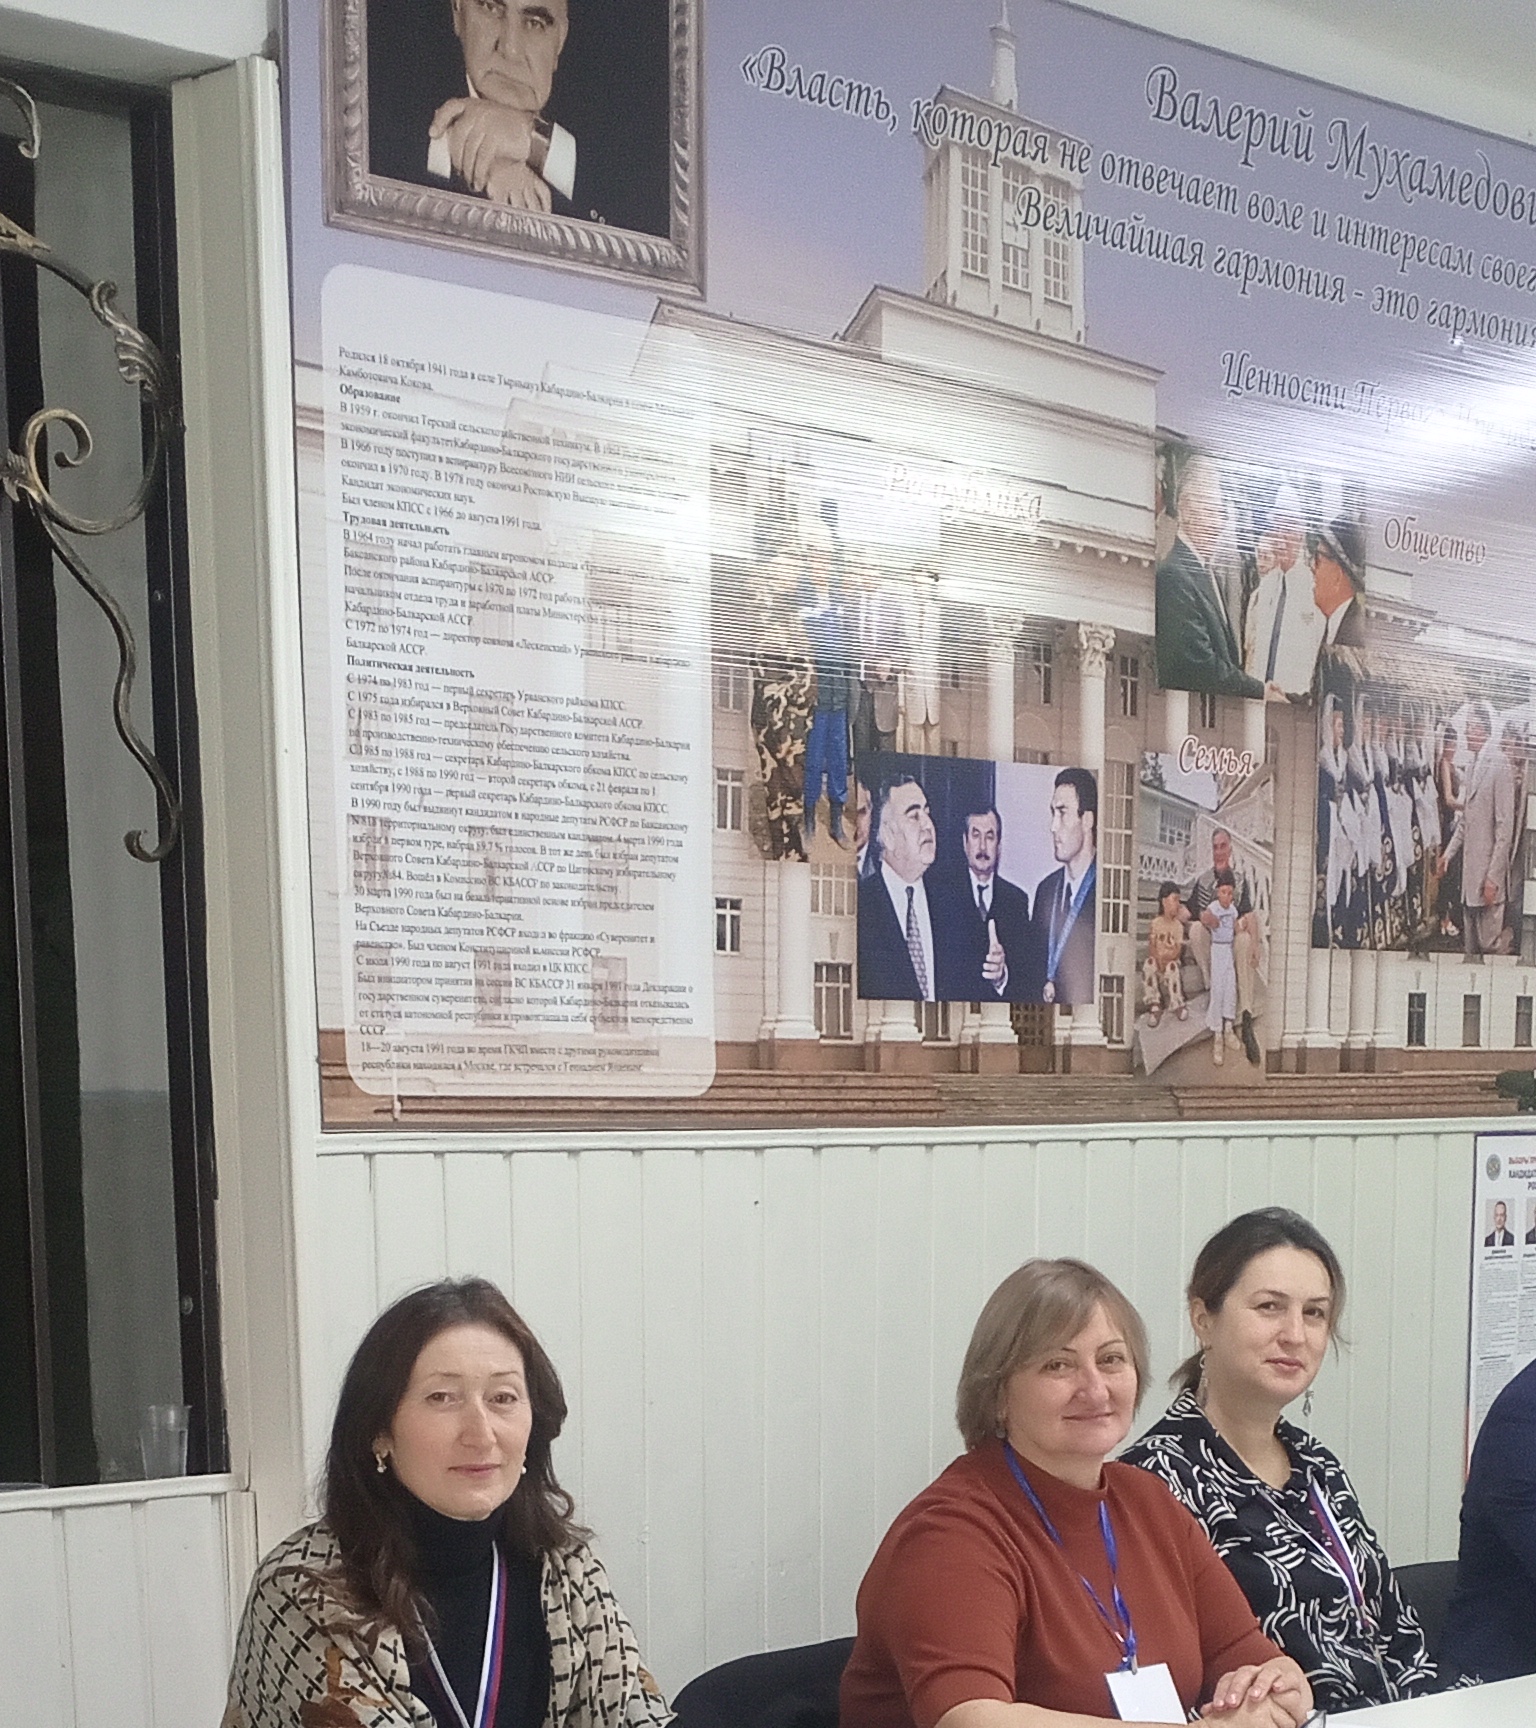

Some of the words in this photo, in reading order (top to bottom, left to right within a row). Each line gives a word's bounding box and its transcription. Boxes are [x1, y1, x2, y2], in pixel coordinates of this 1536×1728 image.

[1146, 64, 1315, 169] Валерий
[740, 45, 898, 135] «Власть,
[911, 96, 1050, 169] которая
[1058, 137, 1092, 174] не
[1100, 152, 1239, 215] отвечает
[1247, 191, 1304, 231] воле
[1312, 209, 1329, 239] и
[1335, 212, 1473, 275] интересам
[1017, 184, 1205, 270] Величайшая
[1213, 243, 1346, 304] гармония
[1370, 284, 1420, 320] это
[339, 383, 401, 404] Образование
[1221, 350, 1349, 415] Ценности
[342, 511, 387, 527] Трудовая
[389, 520, 450, 536] деятельность
[1383, 516, 1487, 565] Общество
[346, 654, 413, 672] Политическая
[415, 664, 475, 678] деятельность
[1179, 736, 1252, 775] Семья
